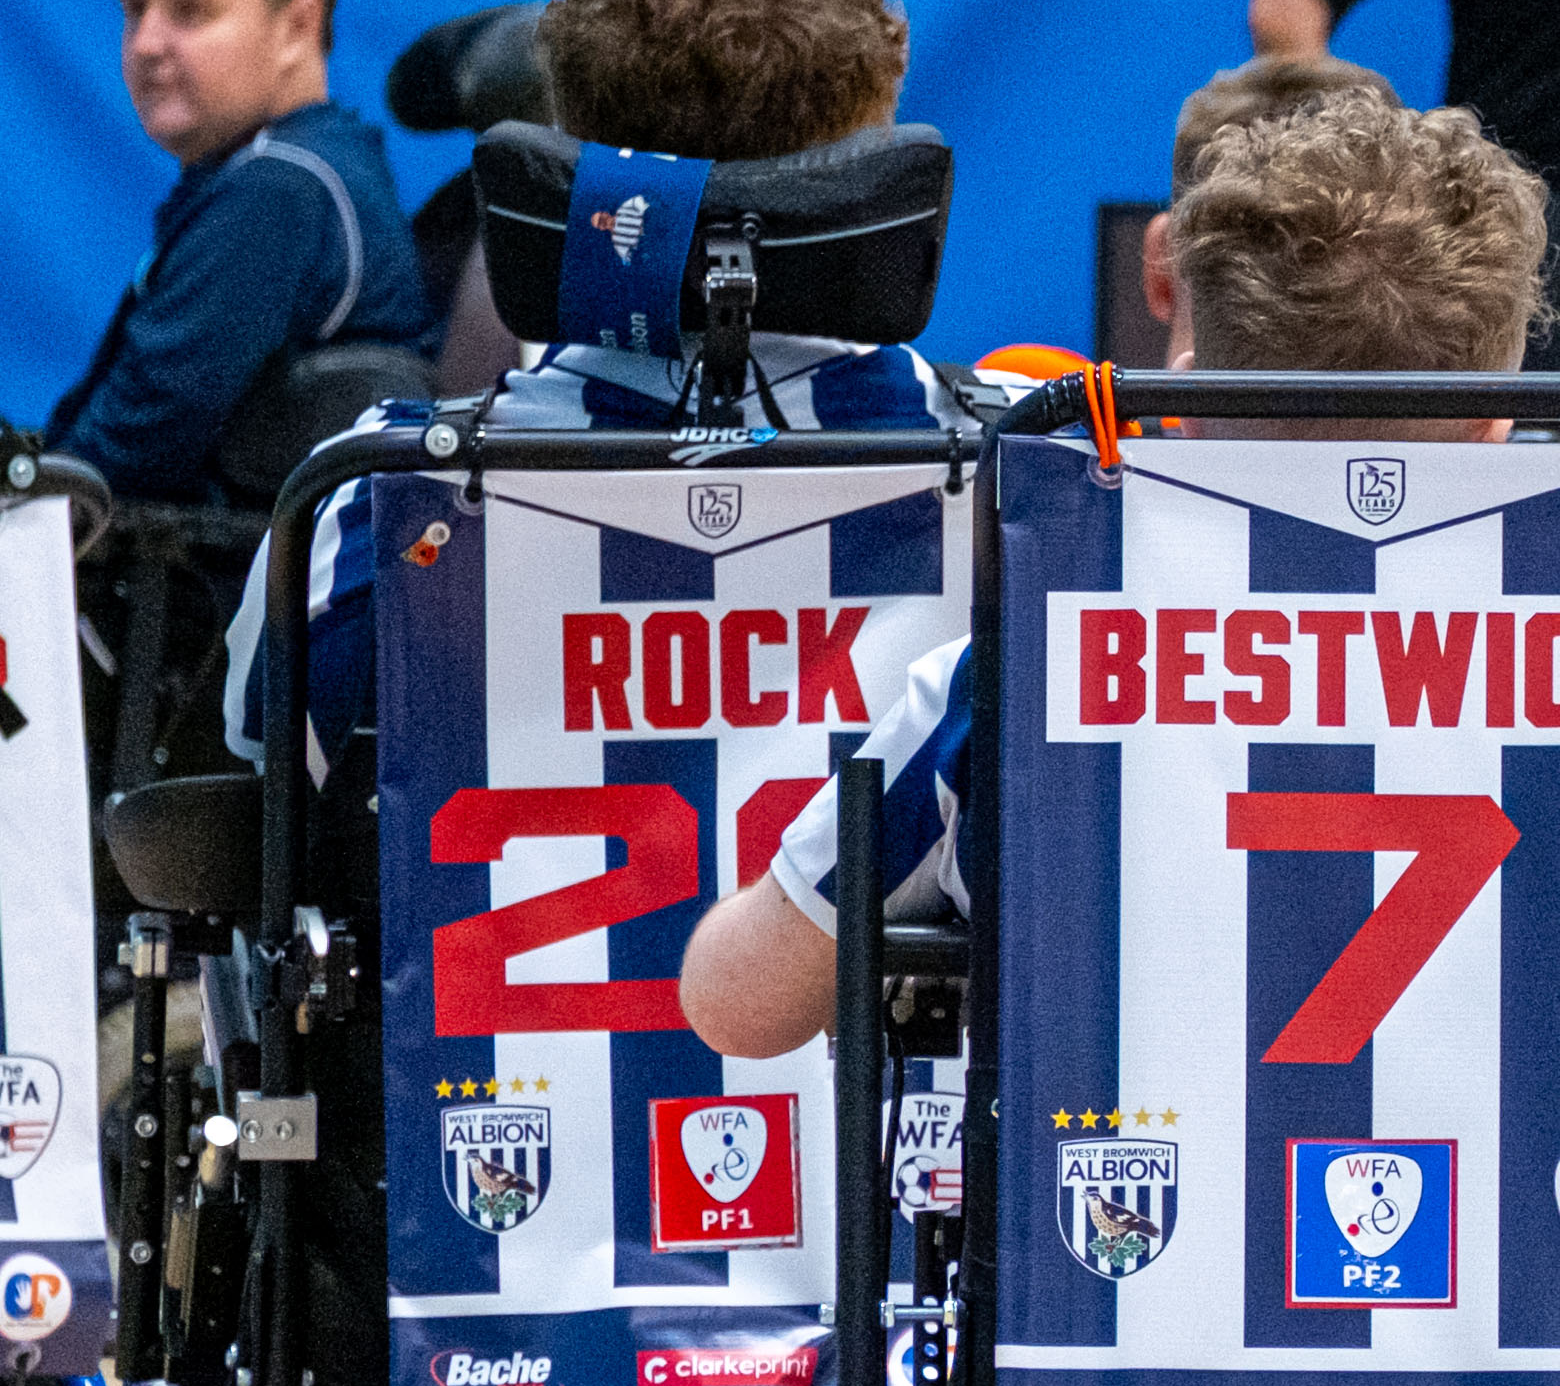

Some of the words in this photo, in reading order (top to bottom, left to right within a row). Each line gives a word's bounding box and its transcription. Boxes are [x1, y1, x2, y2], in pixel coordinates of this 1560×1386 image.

[1357, 470, 1396, 498] 125
[699, 494, 733, 515] 125
[1358, 499, 1395, 508] YEARS
[562, 606, 871, 732] ROCK
[1226, 791, 1522, 1065] 7
[914, 1100, 951, 1118] The
[448, 1122, 544, 1145] ALBION
[699, 1112, 749, 1132] WFA
[1065, 1148, 1099, 1158] WEST
[1103, 1147, 1171, 1158] BROMWICH
[1065, 1158, 1170, 1181] ALBION
[1346, 1159, 1402, 1179] WFA
[701, 1208, 754, 1232] PF1
[1342, 1264, 1402, 1290] PF2
[674, 1354, 810, 1380] clarkeprint
